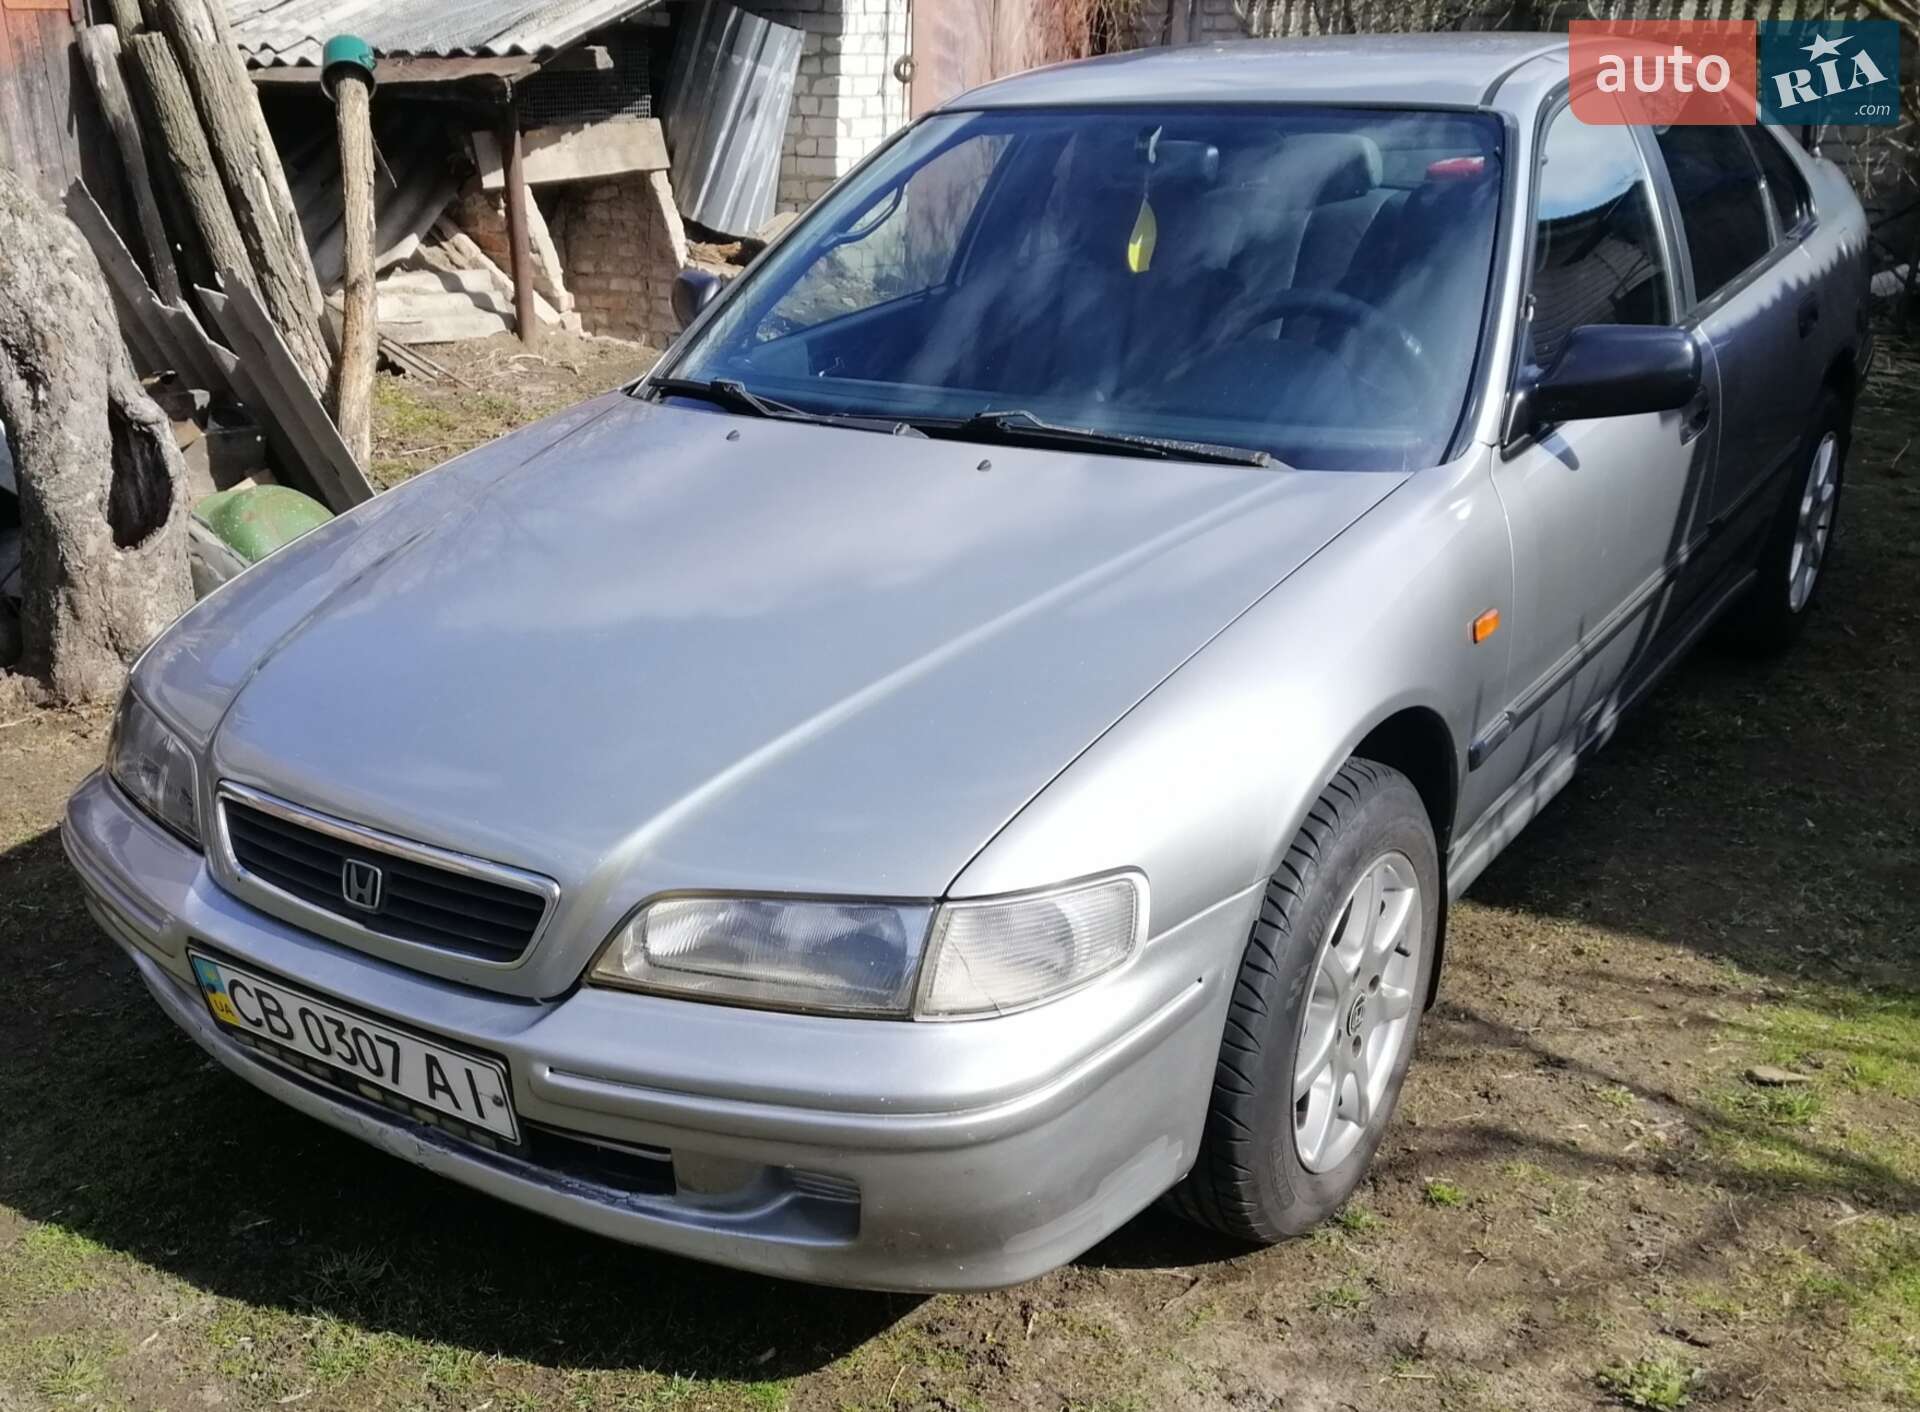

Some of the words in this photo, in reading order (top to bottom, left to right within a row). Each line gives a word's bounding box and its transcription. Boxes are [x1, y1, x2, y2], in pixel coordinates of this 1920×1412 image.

[228, 979, 294, 1040] CB
[299, 1007, 401, 1085] 0307
[425, 1052, 486, 1120] AI
